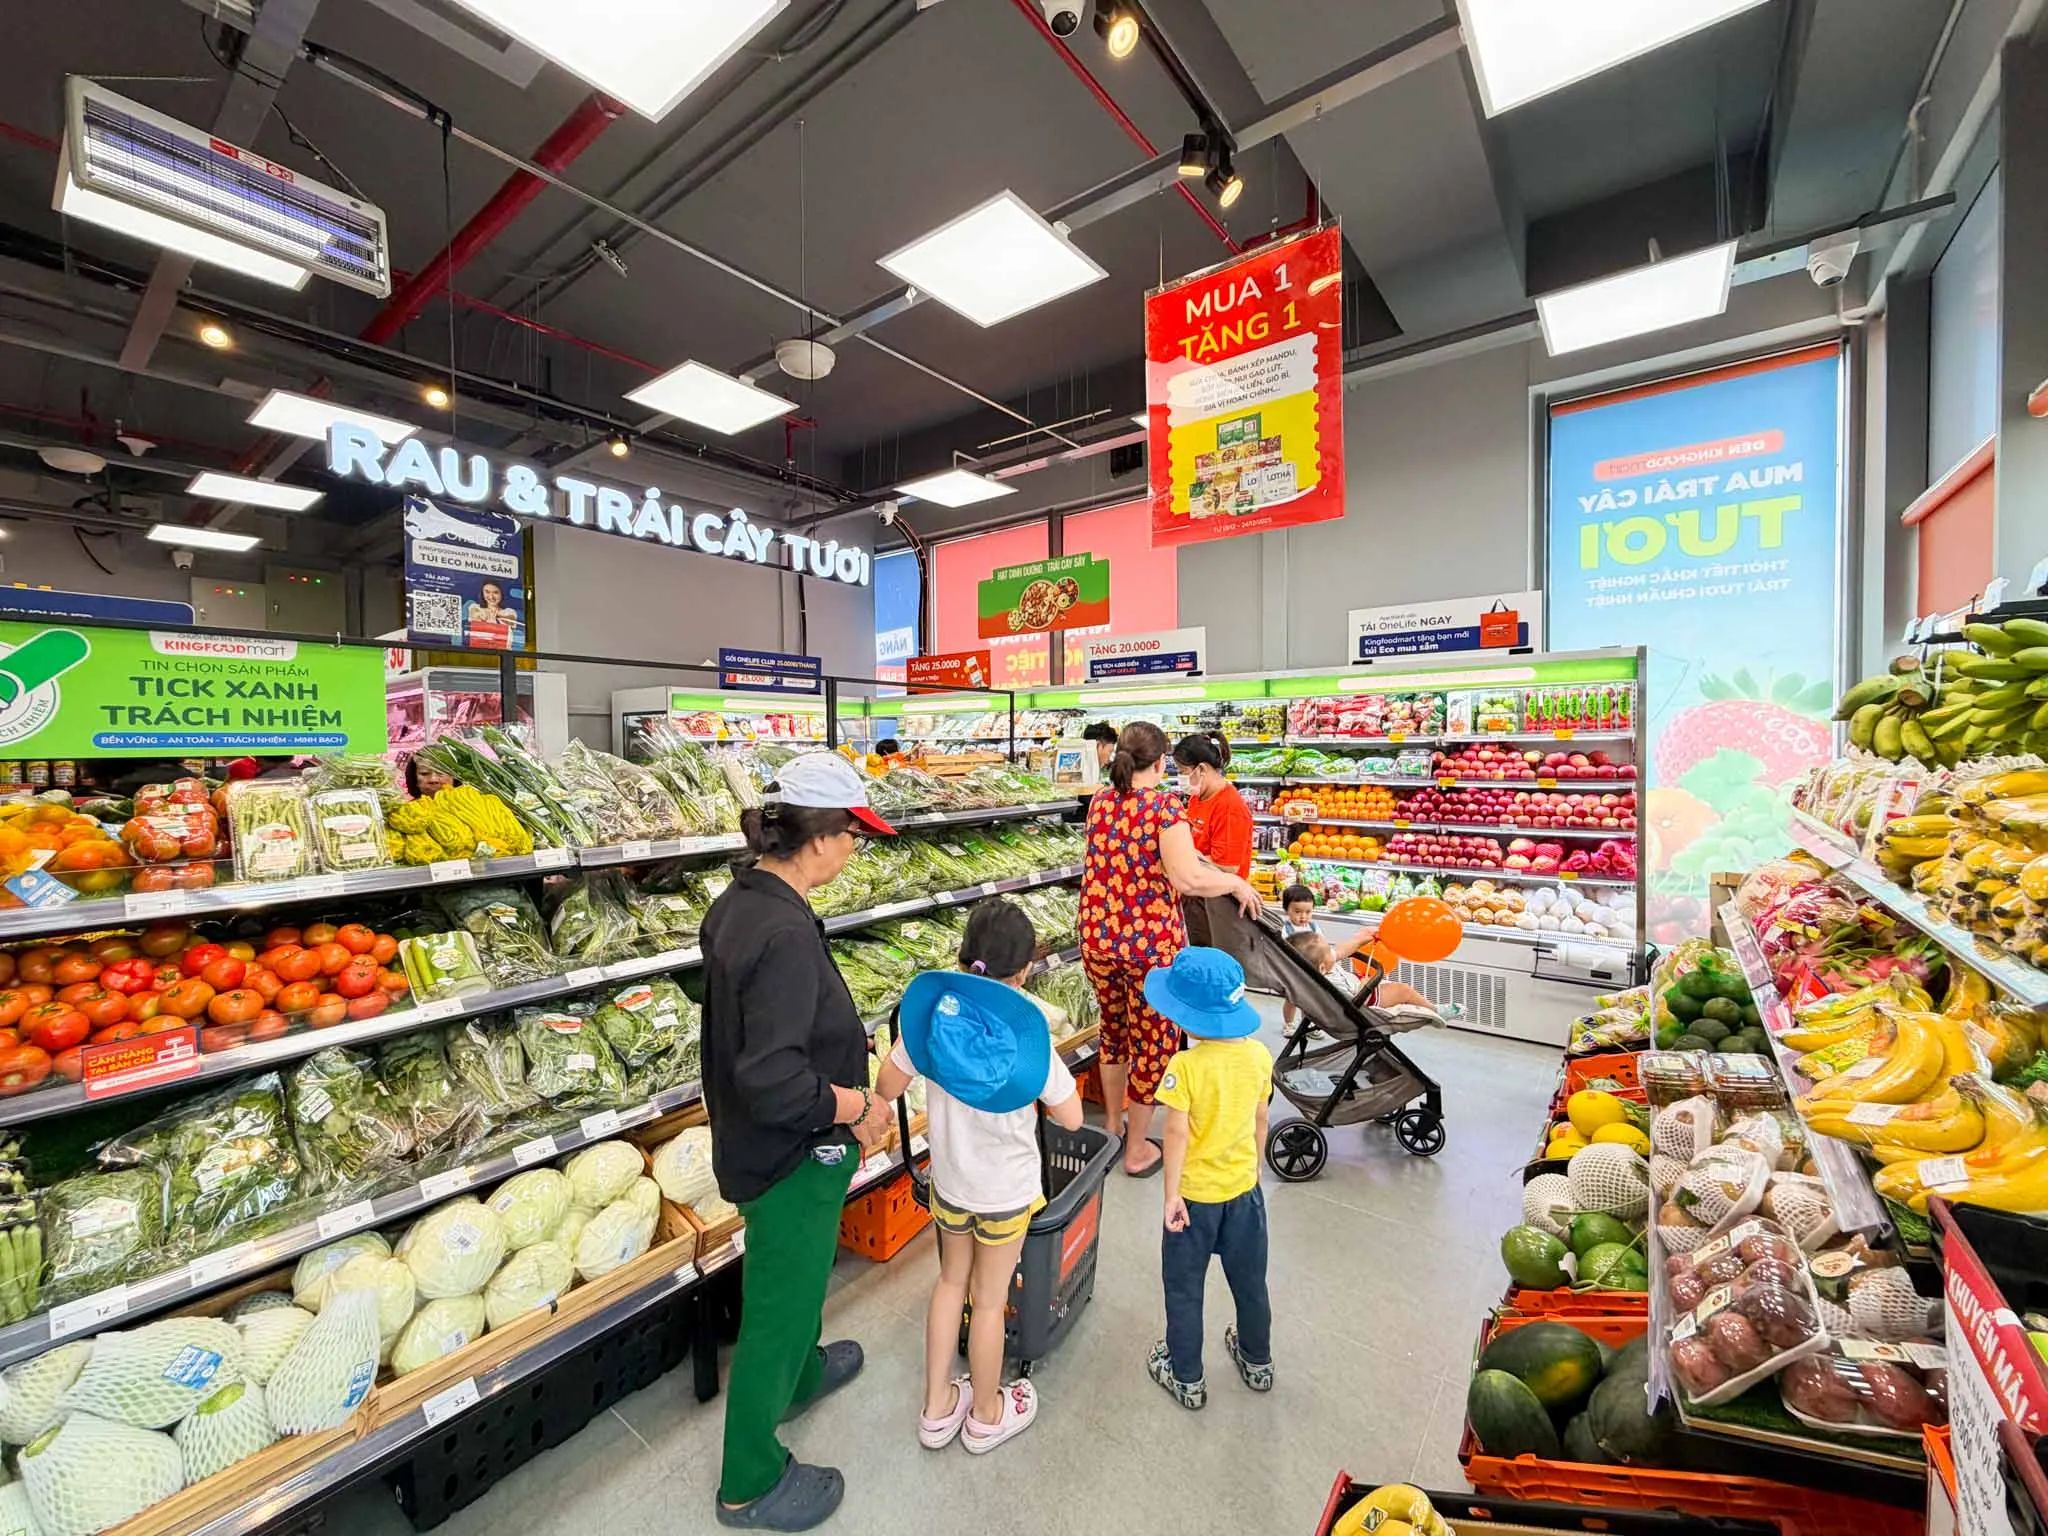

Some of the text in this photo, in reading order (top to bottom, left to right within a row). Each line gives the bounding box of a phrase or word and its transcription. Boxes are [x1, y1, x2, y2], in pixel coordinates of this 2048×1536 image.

[1186, 263, 1293, 325] MUA 1
[1178, 301, 1302, 364] TẶNG 1
[328, 420, 871, 587] RAU & TRÁI CÂY TƯƠI
[420, 552, 513, 575] TÚI ECO MUA SẮM
[1360, 615, 1453, 632] TẢI OneLife NGAY
[1364, 630, 1470, 647] Kingfoodmart tặng bạn mới
[164, 639, 286, 657] KINGFOODmart
[1089, 644, 1117, 657] TẶNG
[1119, 640, 1160, 653] 20.000Đ
[1364, 641, 1439, 655] túi Eco mua sắm
[174, 662, 224, 675] CHỌN
[227, 663, 261, 675] SẢN
[265, 664, 310, 677] PHẨM
[910, 659, 961, 674] TẶNG 25.000Đ
[130, 675, 319, 701] TICK XANH
[100, 700, 343, 732] TRÁCH NHIỆM
[126, 733, 159, 745] VỮNG
[167, 736, 183, 745] AN
[185, 734, 214, 745] TOÀN
[222, 735, 255, 745] TRÁCH
[256, 736, 287, 746] NHIỆM
[294, 737, 318, 745] MINH
[318, 736, 343, 746] BẠCH
[88, 1055, 116, 1068] CÂN
[118, 1047, 155, 1061] HÀNG
[133, 1054, 155, 1066] CÂN
[1949, 1267, 1999, 1362] KHUYẾN
[1993, 1349, 2030, 1424] MÃI
